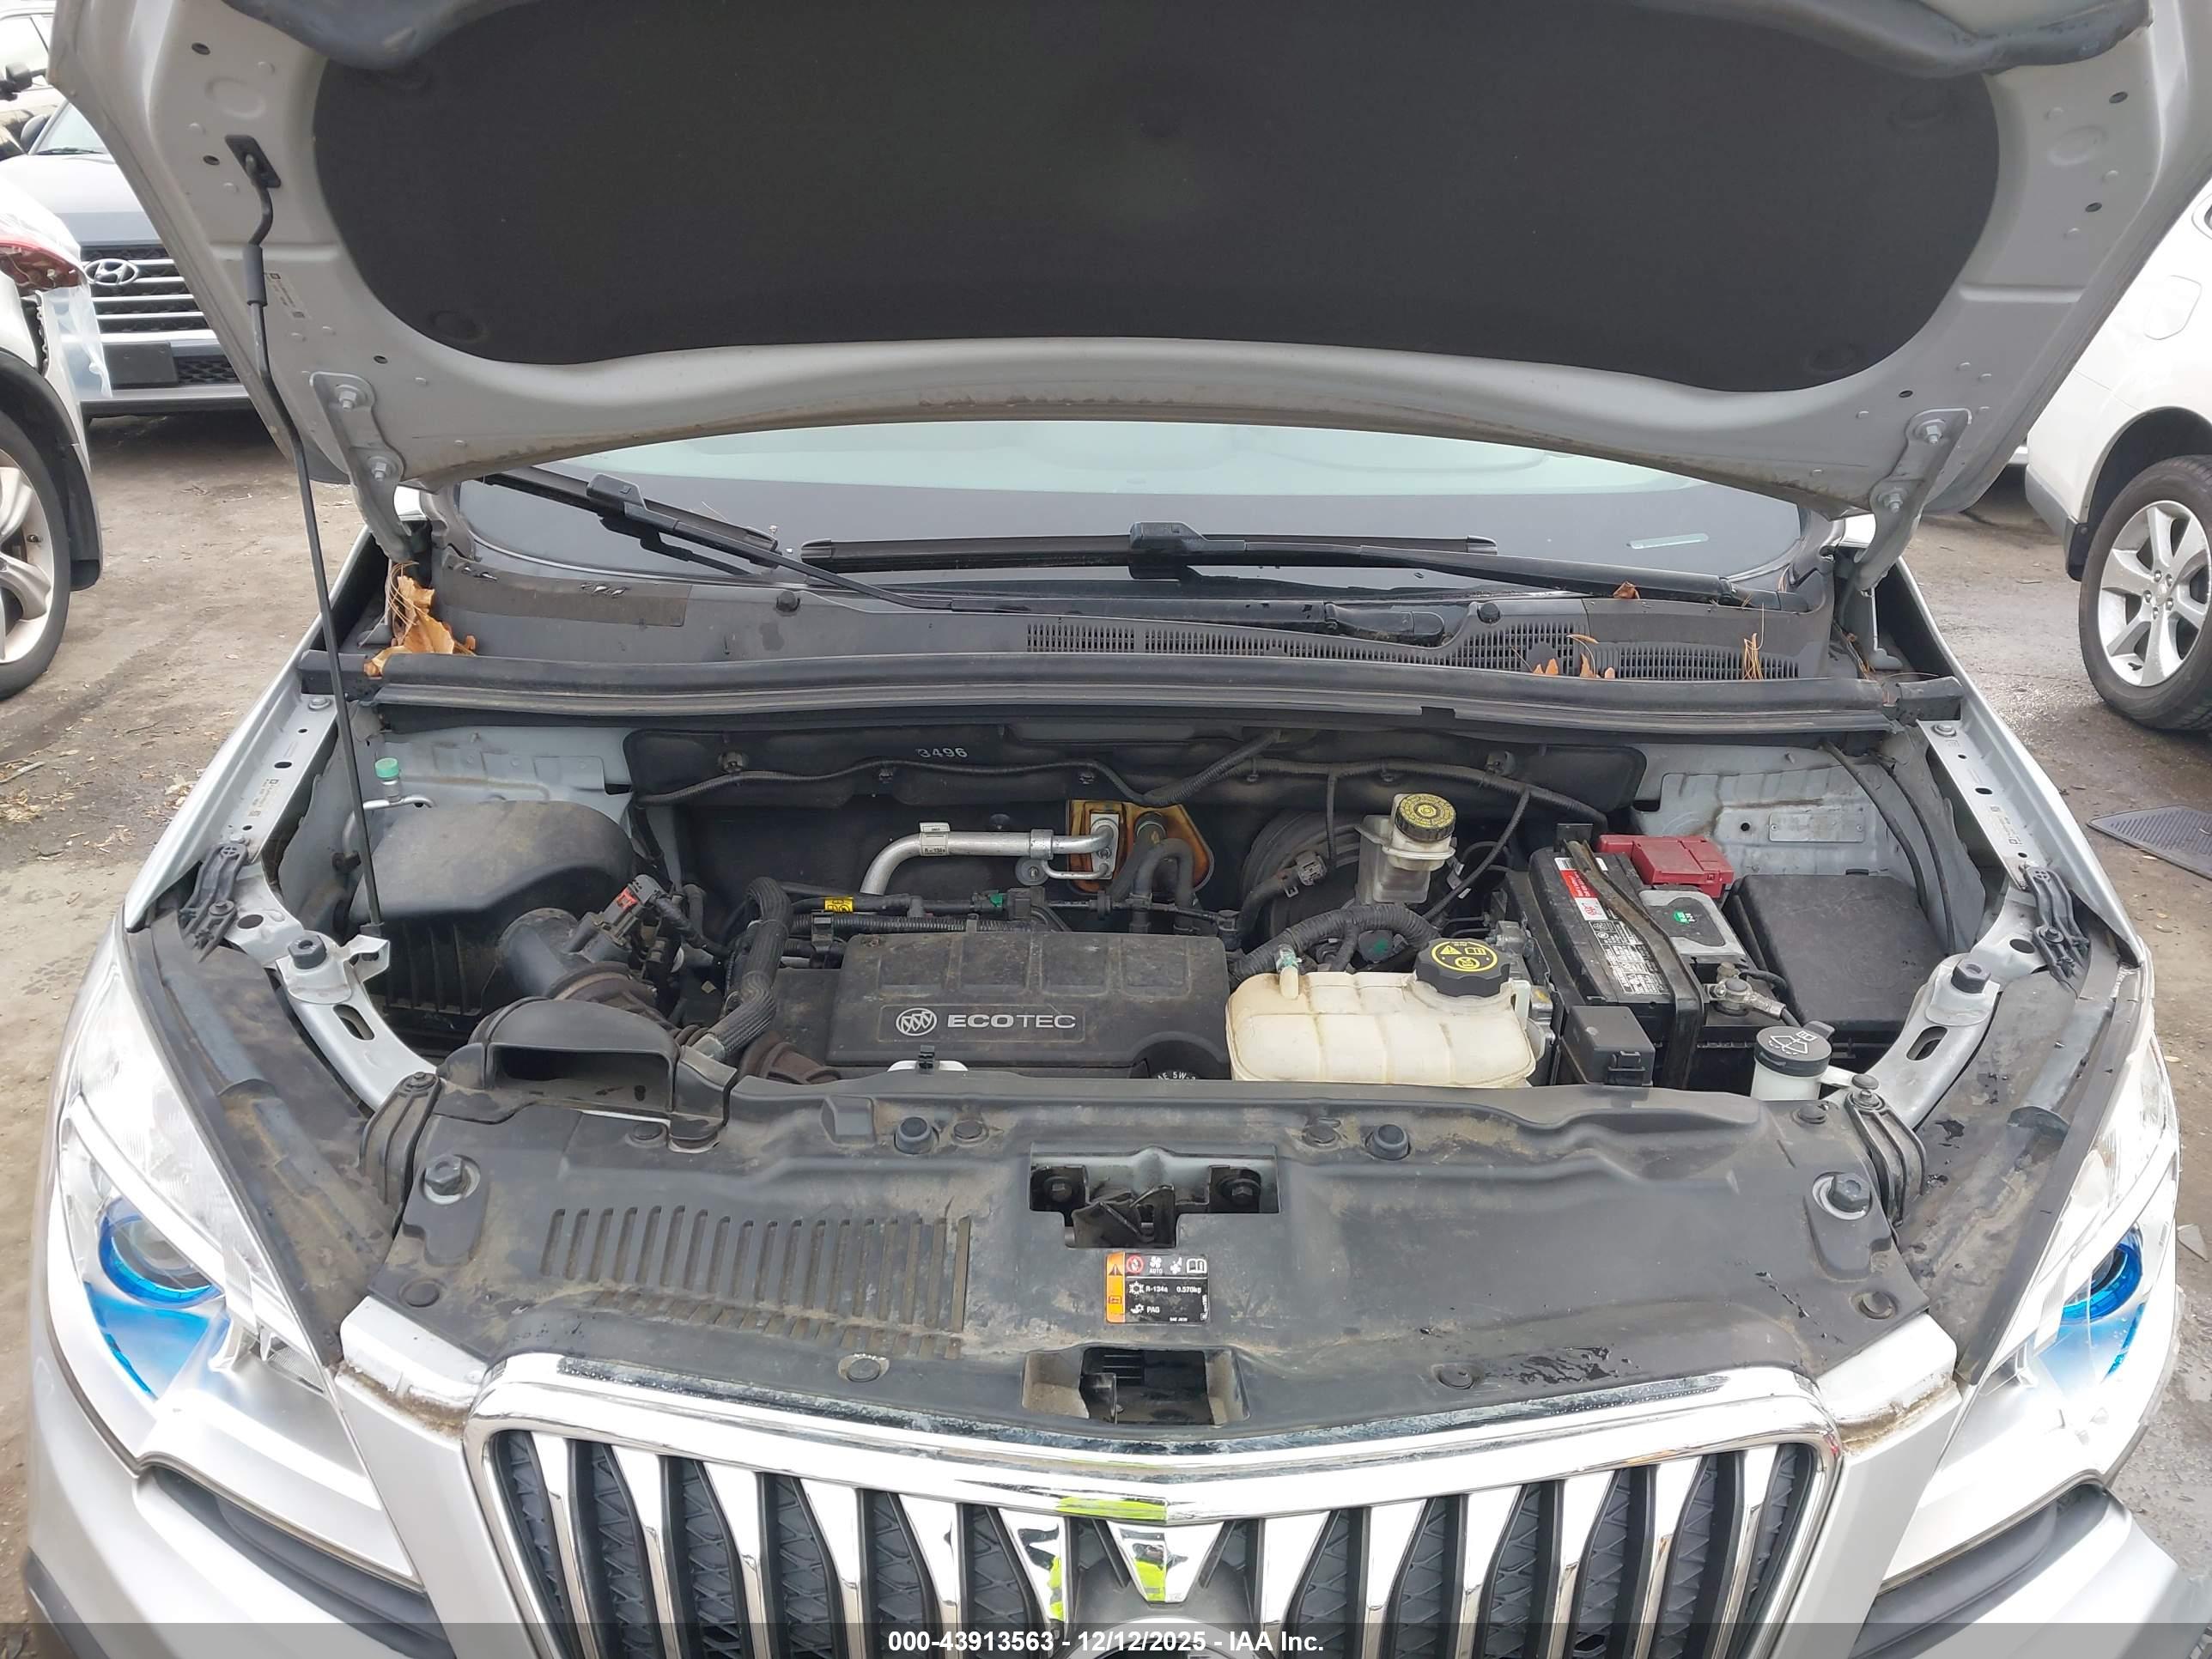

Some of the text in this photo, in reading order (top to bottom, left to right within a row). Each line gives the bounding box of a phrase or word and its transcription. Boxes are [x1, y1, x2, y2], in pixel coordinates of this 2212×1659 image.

[916, 747, 968, 757] 3496
[947, 1013, 1076, 1029] ECOTEC
[1176, 1285, 1201, 1294] 0.570kg
